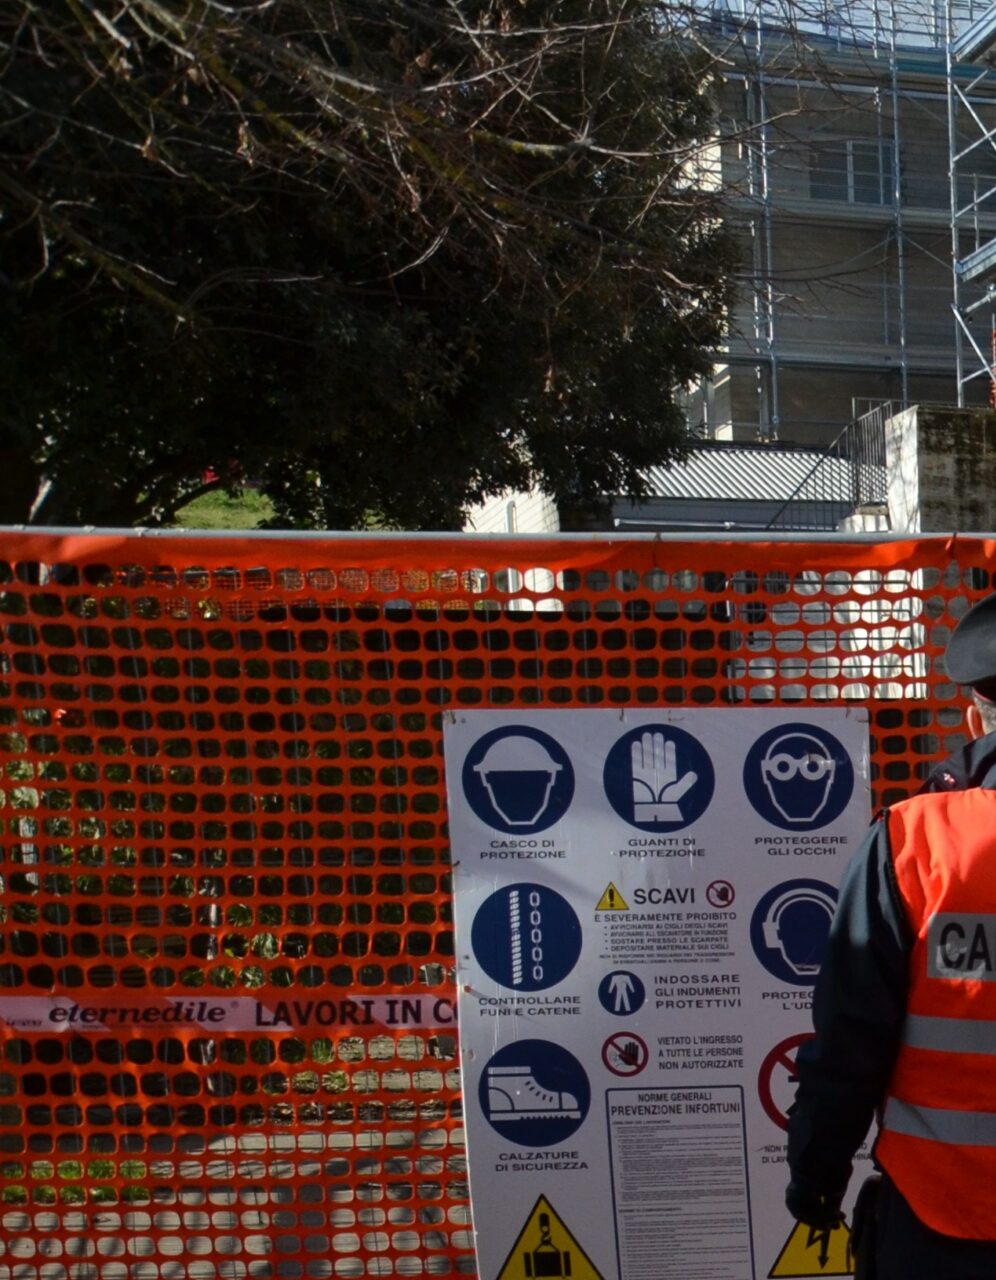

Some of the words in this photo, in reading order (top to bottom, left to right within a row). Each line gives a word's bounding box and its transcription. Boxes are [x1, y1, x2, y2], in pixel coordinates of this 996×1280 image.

[489, 839, 538, 849] CASCO
[542, 839, 556, 848] DI
[628, 838, 679, 847] GUANTI
[683, 838, 696, 846] DI
[754, 836, 848, 845] PROTEGGERE
[480, 850, 567, 860] PROTEZIONE
[619, 849, 706, 858] PROTEZIONE
[767, 847, 790, 856] GLI
[793, 847, 837, 856] OCCHI
[633, 887, 696, 905] SCAVI
[604, 912, 684, 922] SEVERAMENTE
[686, 911, 738, 921] PROIBITO
[654, 974, 741, 985] INDOSSARE
[655, 987, 674, 997] GLI
[677, 986, 741, 996] INDUMENTI
[478, 996, 582, 1006] CONTROLLARE
[655, 999, 742, 1009] PROTETTIVI
[48, 1000, 227, 1024] eternedile
[255, 999, 375, 1026] LAVORI
[386, 999, 422, 1024] IN
[479, 1008, 511, 1017] FUNI
[514, 1007, 524, 1016] E
[527, 1006, 582, 1016] CATENE
[657, 1035, 692, 1045] VIETATO
[658, 1048, 665, 1058] A
[666, 1048, 691, 1058] TUTTE
[693, 1048, 704, 1057] LE
[705, 1047, 744, 1057] PERSONE
[658, 1061, 680, 1070] NON
[681, 1060, 744, 1070] AUTORIZZATE
[638, 1092, 669, 1102] NORME
[670, 1091, 712, 1101] GENERALI
[611, 1104, 683, 1116] PREVENZIONE
[685, 1102, 741, 1114] INFORTUNI
[498, 1151, 580, 1161] CALZATURE
[495, 1163, 509, 1172] DI
[512, 1162, 589, 1172] SICUREZZA
